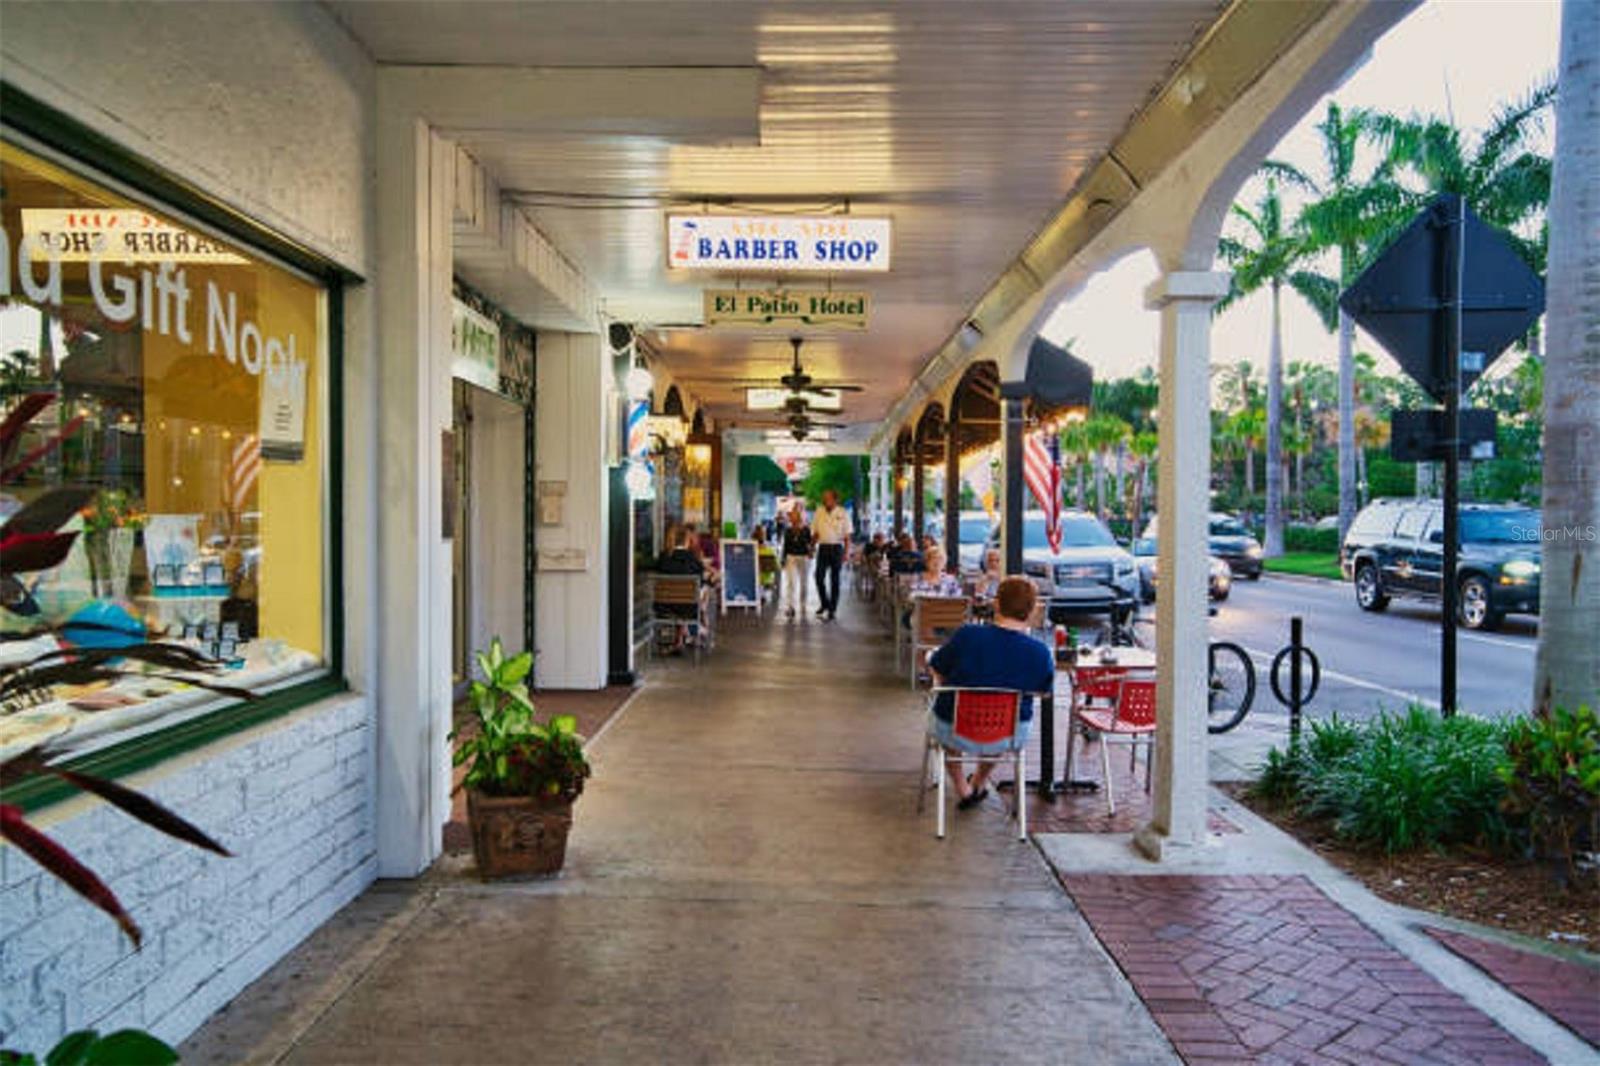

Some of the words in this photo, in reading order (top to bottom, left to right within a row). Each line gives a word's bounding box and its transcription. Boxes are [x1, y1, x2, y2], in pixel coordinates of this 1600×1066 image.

[698, 237, 799, 260] BARBER
[815, 239, 879, 261] SHOP
[88, 232, 192, 344] Gift
[715, 296, 736, 313] El
[747, 296, 799, 314] Patio
[809, 297, 865, 315] Hotel
